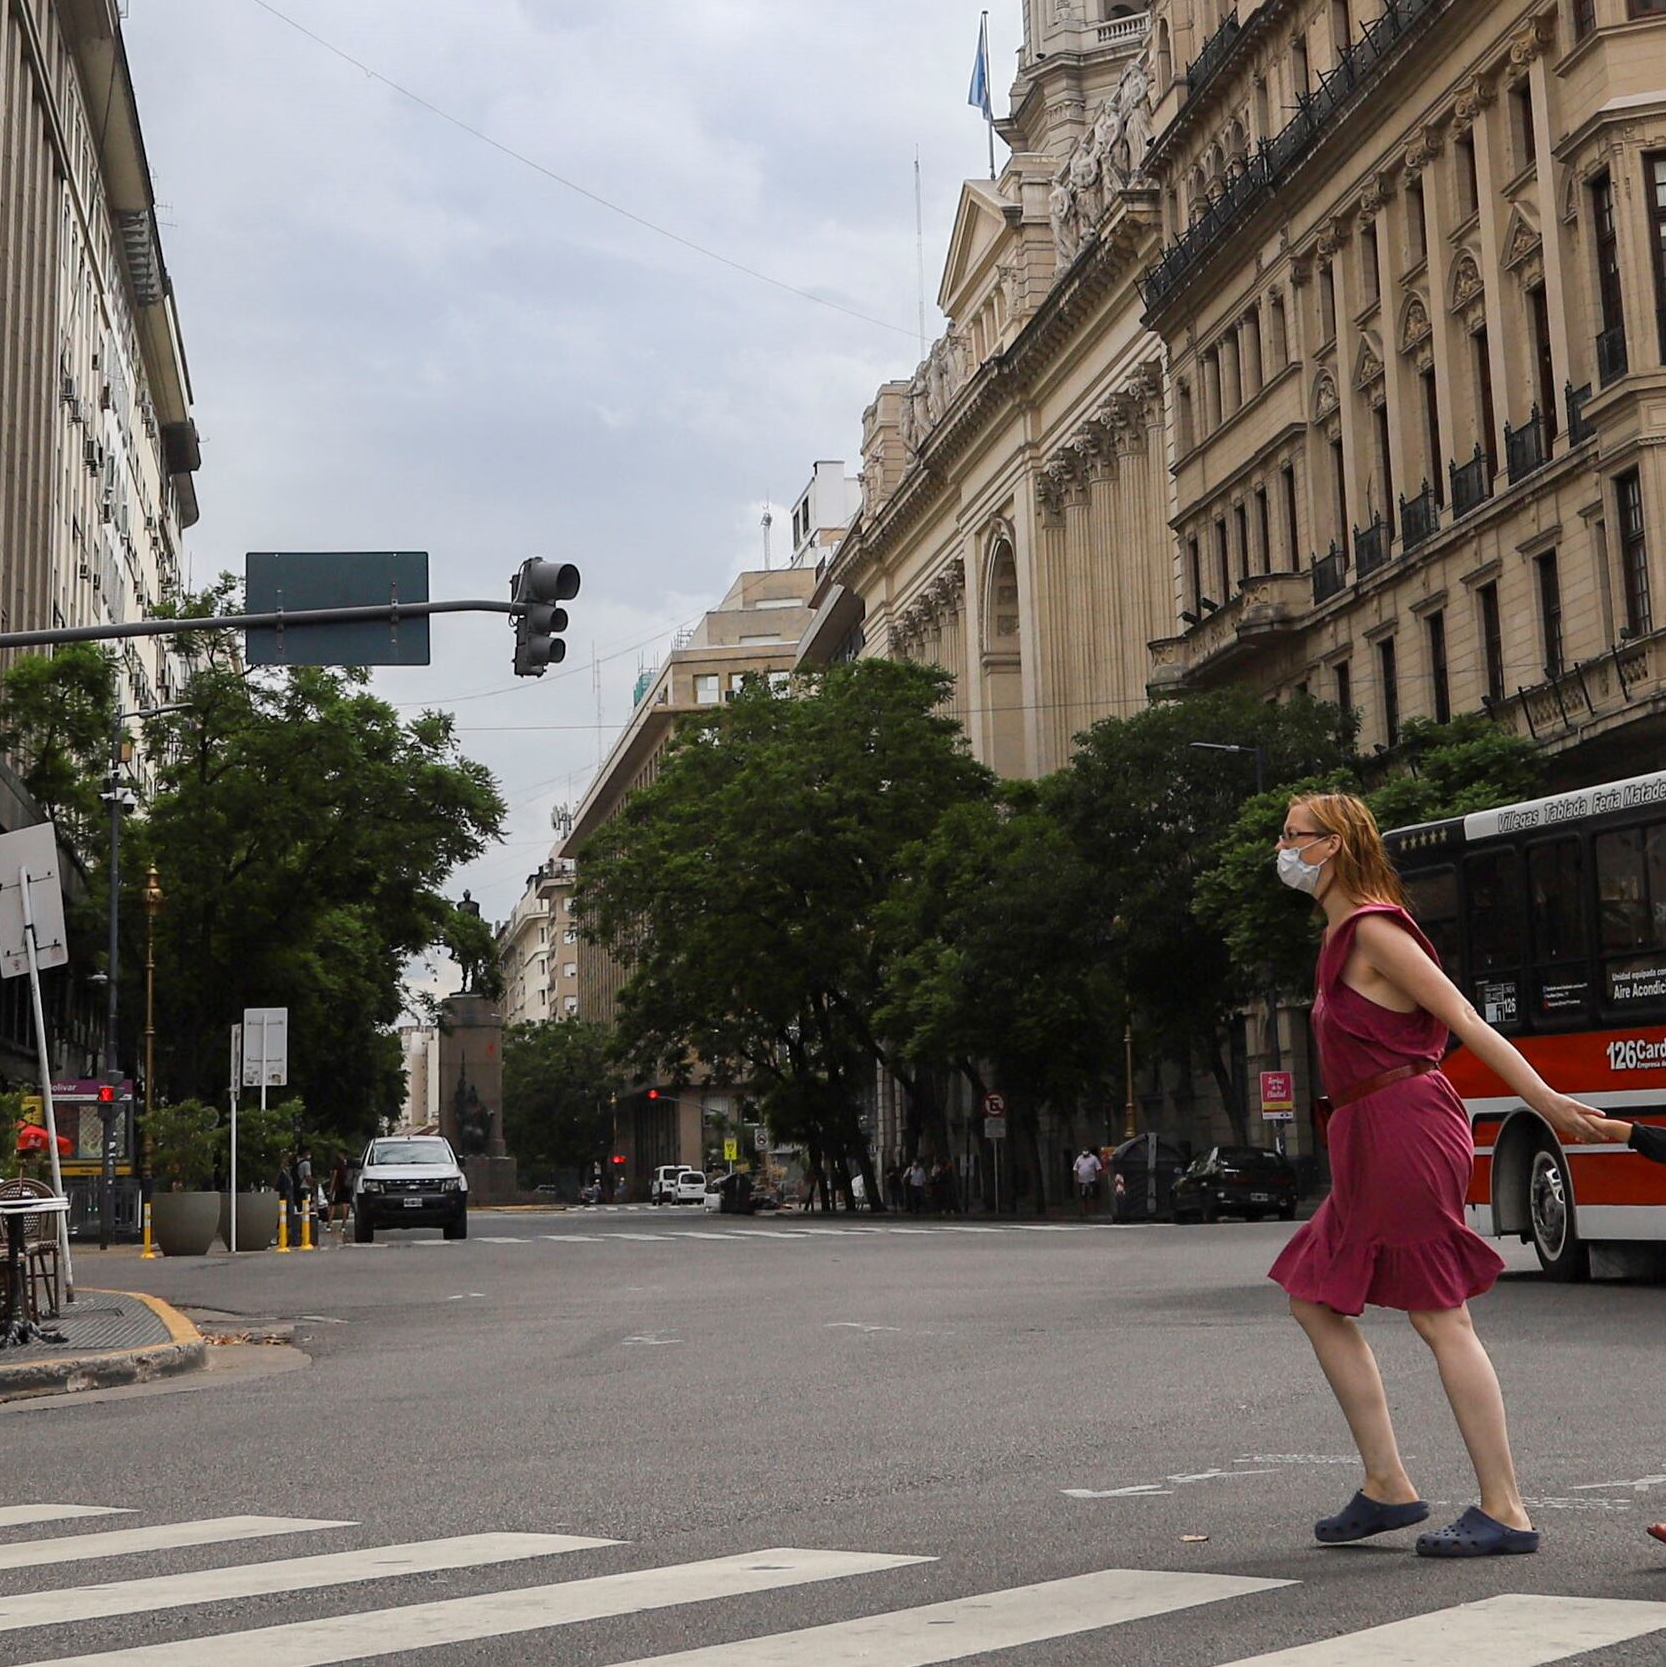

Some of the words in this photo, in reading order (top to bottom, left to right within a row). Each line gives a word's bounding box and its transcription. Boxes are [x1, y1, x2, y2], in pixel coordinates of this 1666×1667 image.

[1497, 807, 1539, 833] Villegas
[1544, 798, 1587, 824] Tablada
[1592, 789, 1621, 815] Feria
[1614, 984, 1631, 1000] Aire
[1607, 1040, 1637, 1070] 126
